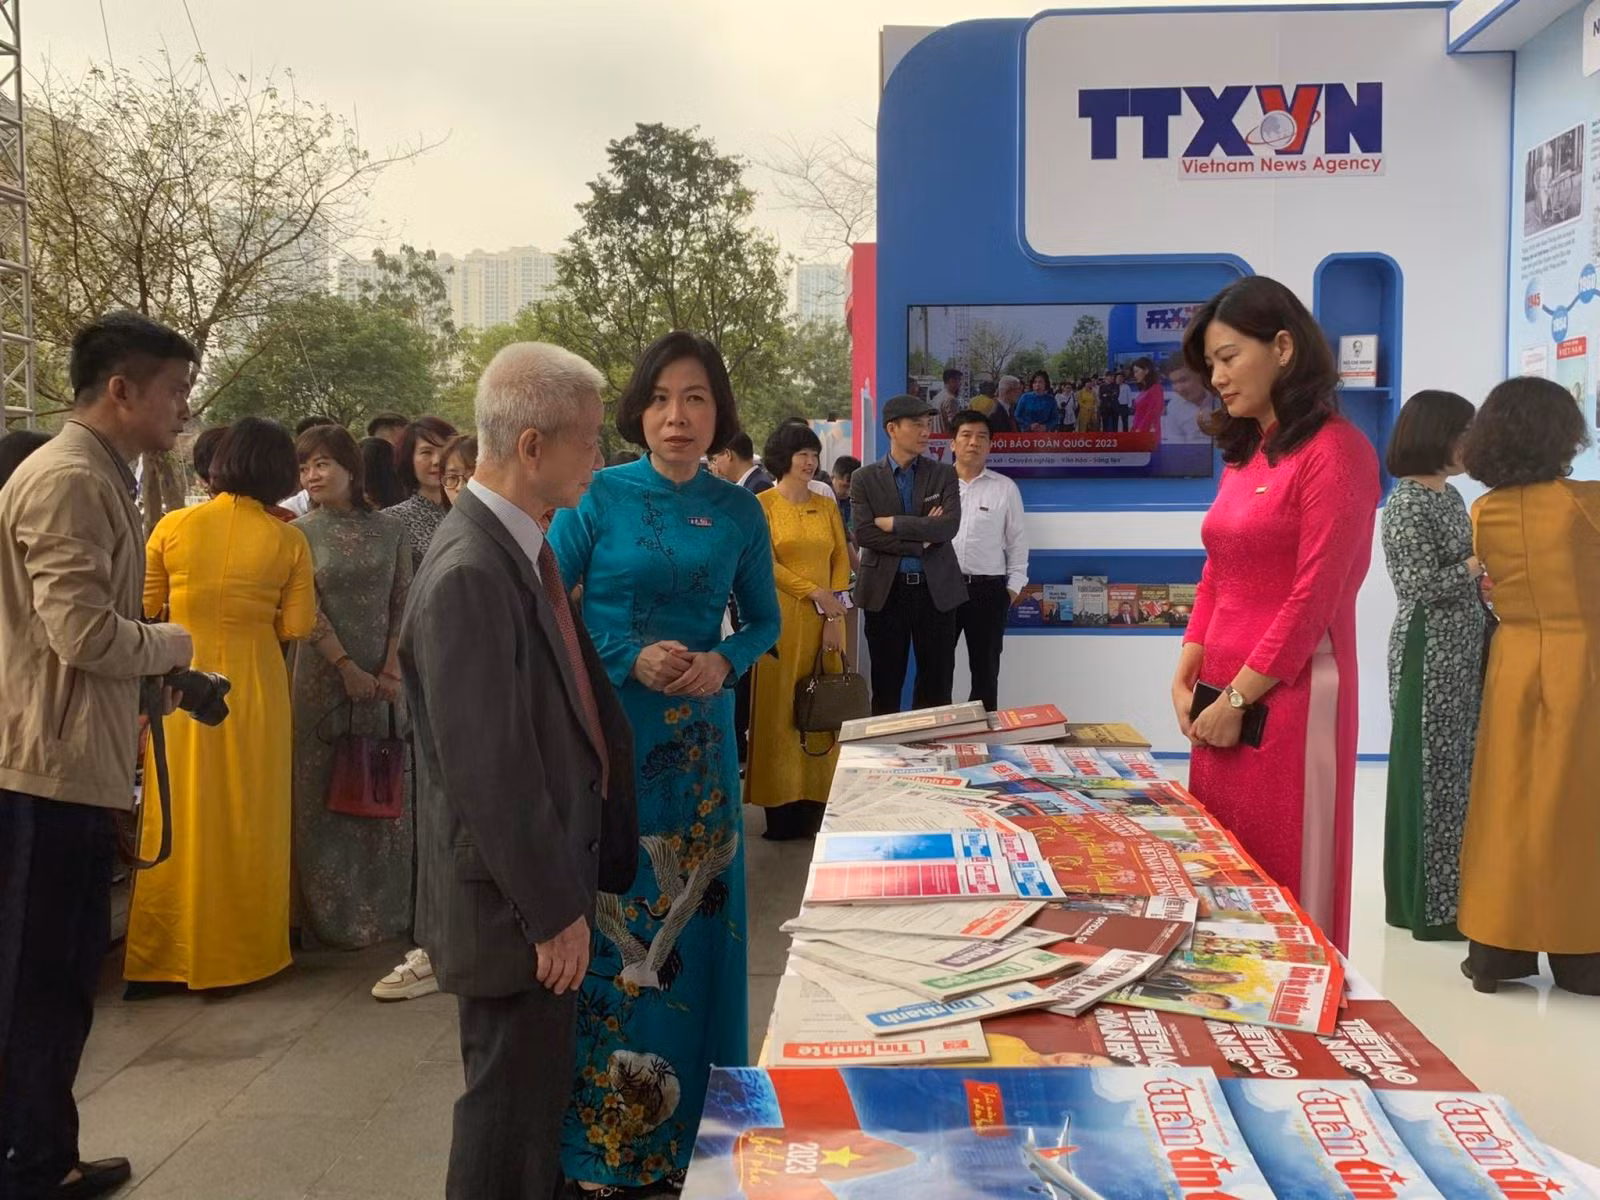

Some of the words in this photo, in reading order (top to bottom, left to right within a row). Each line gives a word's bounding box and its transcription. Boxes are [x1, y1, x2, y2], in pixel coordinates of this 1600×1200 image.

[1078, 82, 1383, 160] TTXVN
[1182, 158, 1254, 173] Vietnam
[1260, 157, 1306, 171] News
[1312, 155, 1382, 174] Agency
[1095, 439, 1118, 448] 2023
[824, 1044, 872, 1057] kinh
[784, 1142, 819, 1174] 2023
